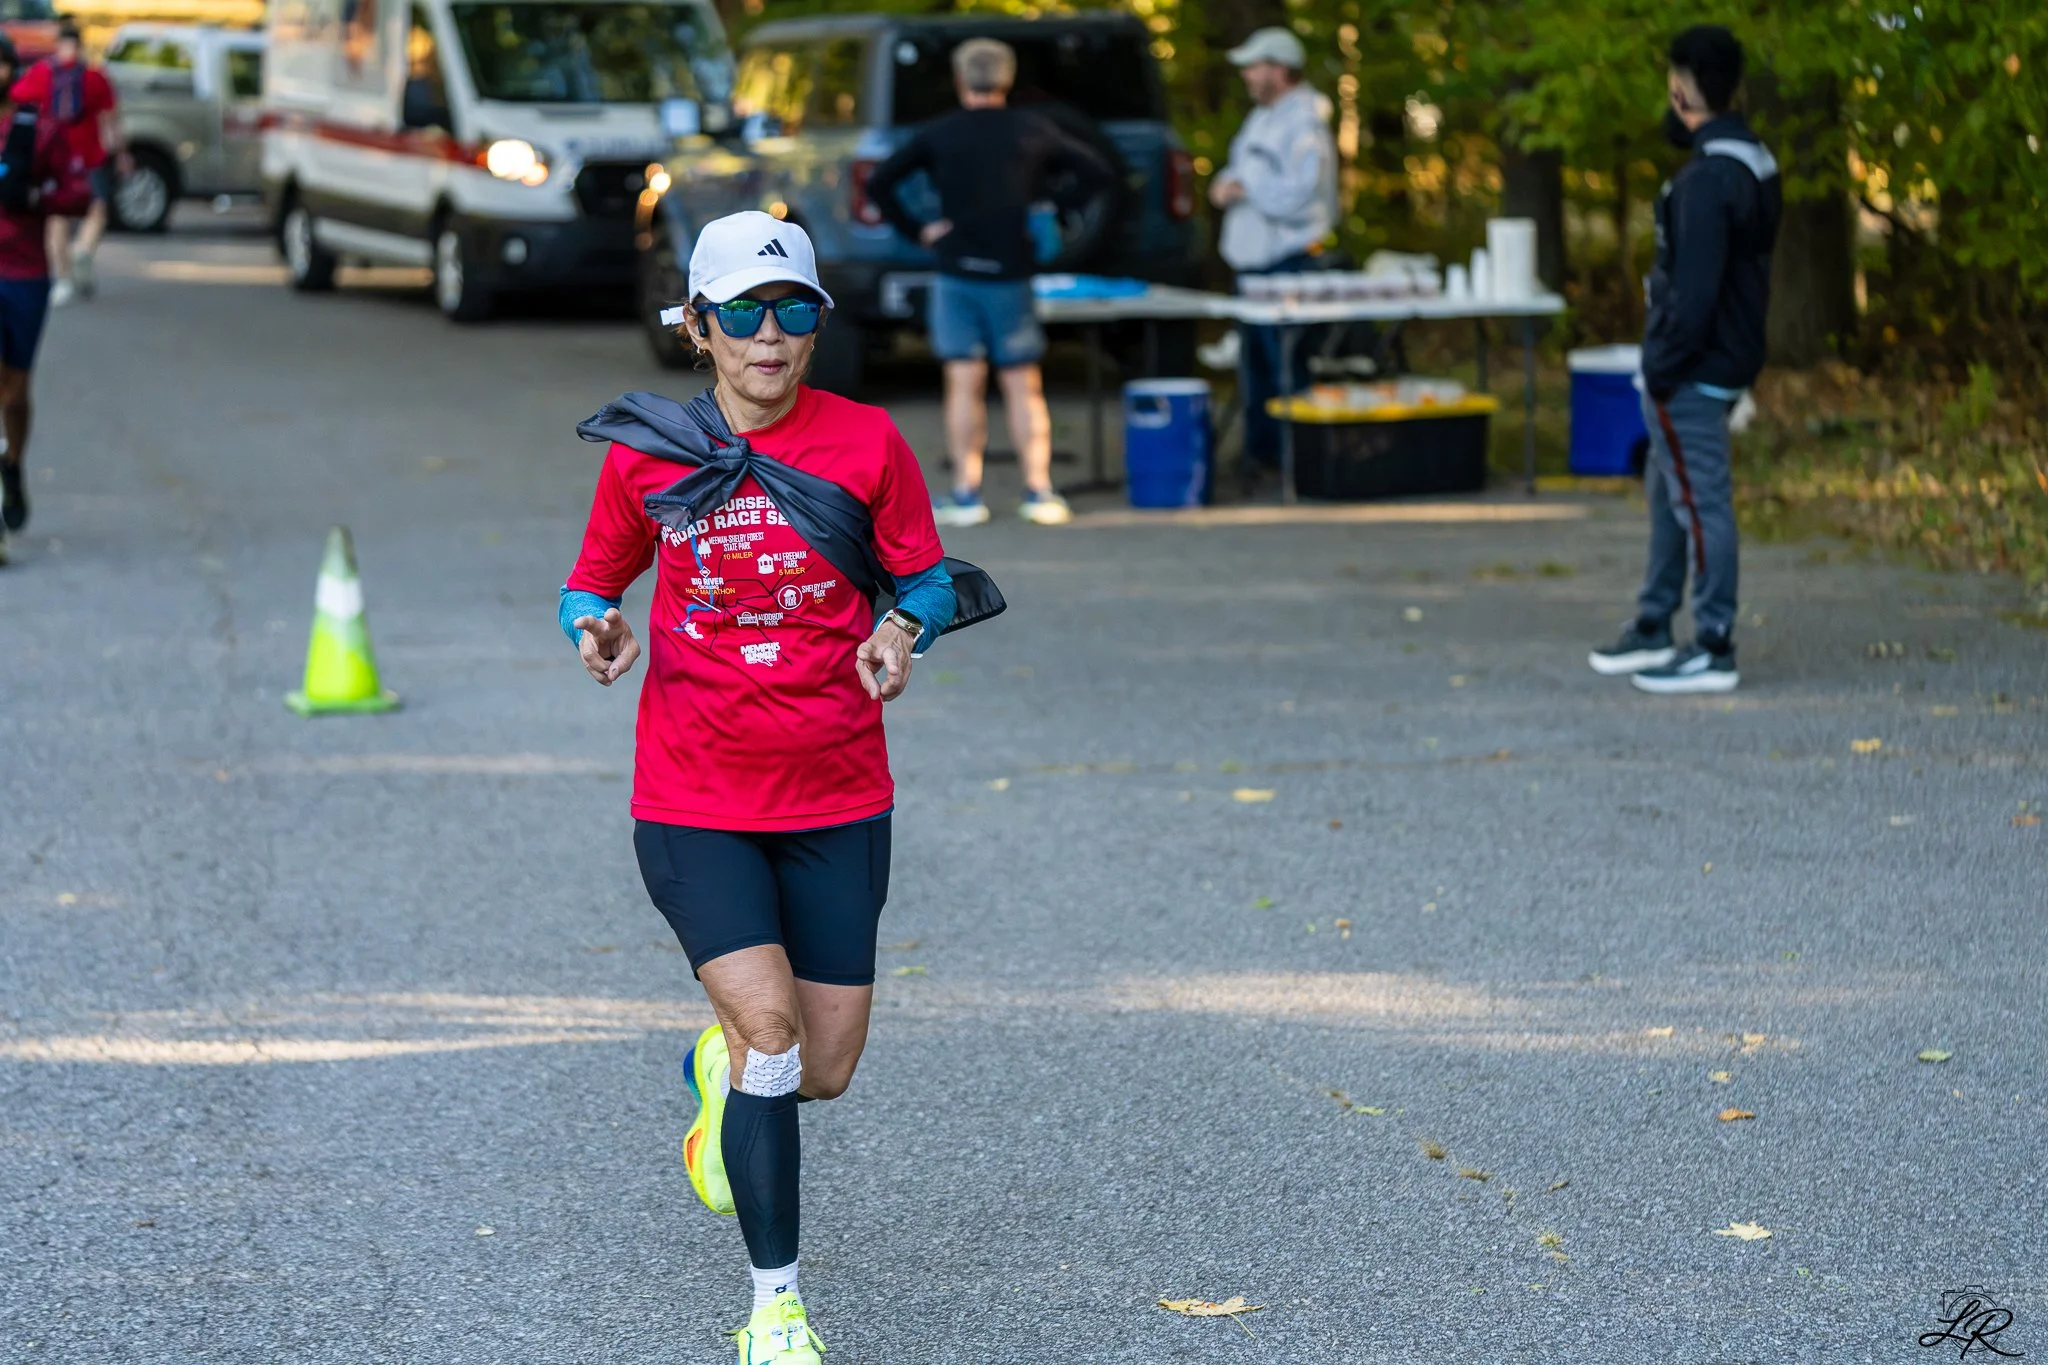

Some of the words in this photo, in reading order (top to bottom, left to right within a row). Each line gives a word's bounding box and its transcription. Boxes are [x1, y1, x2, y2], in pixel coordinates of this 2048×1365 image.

[714, 510, 761, 530] RACE
[766, 510, 791, 526] SE
[723, 542, 738, 552] STATE
[738, 542, 751, 551] PARK
[732, 552, 753, 560] MILER
[782, 551, 807, 561] FREEMAN
[783, 560, 798, 569] PARK
[784, 567, 806, 576] MILER
[801, 583, 820, 594] SHELBY
[820, 580, 836, 590] FARMS
[813, 589, 826, 599] PARK
[740, 642, 780, 655] MEMPHIS
